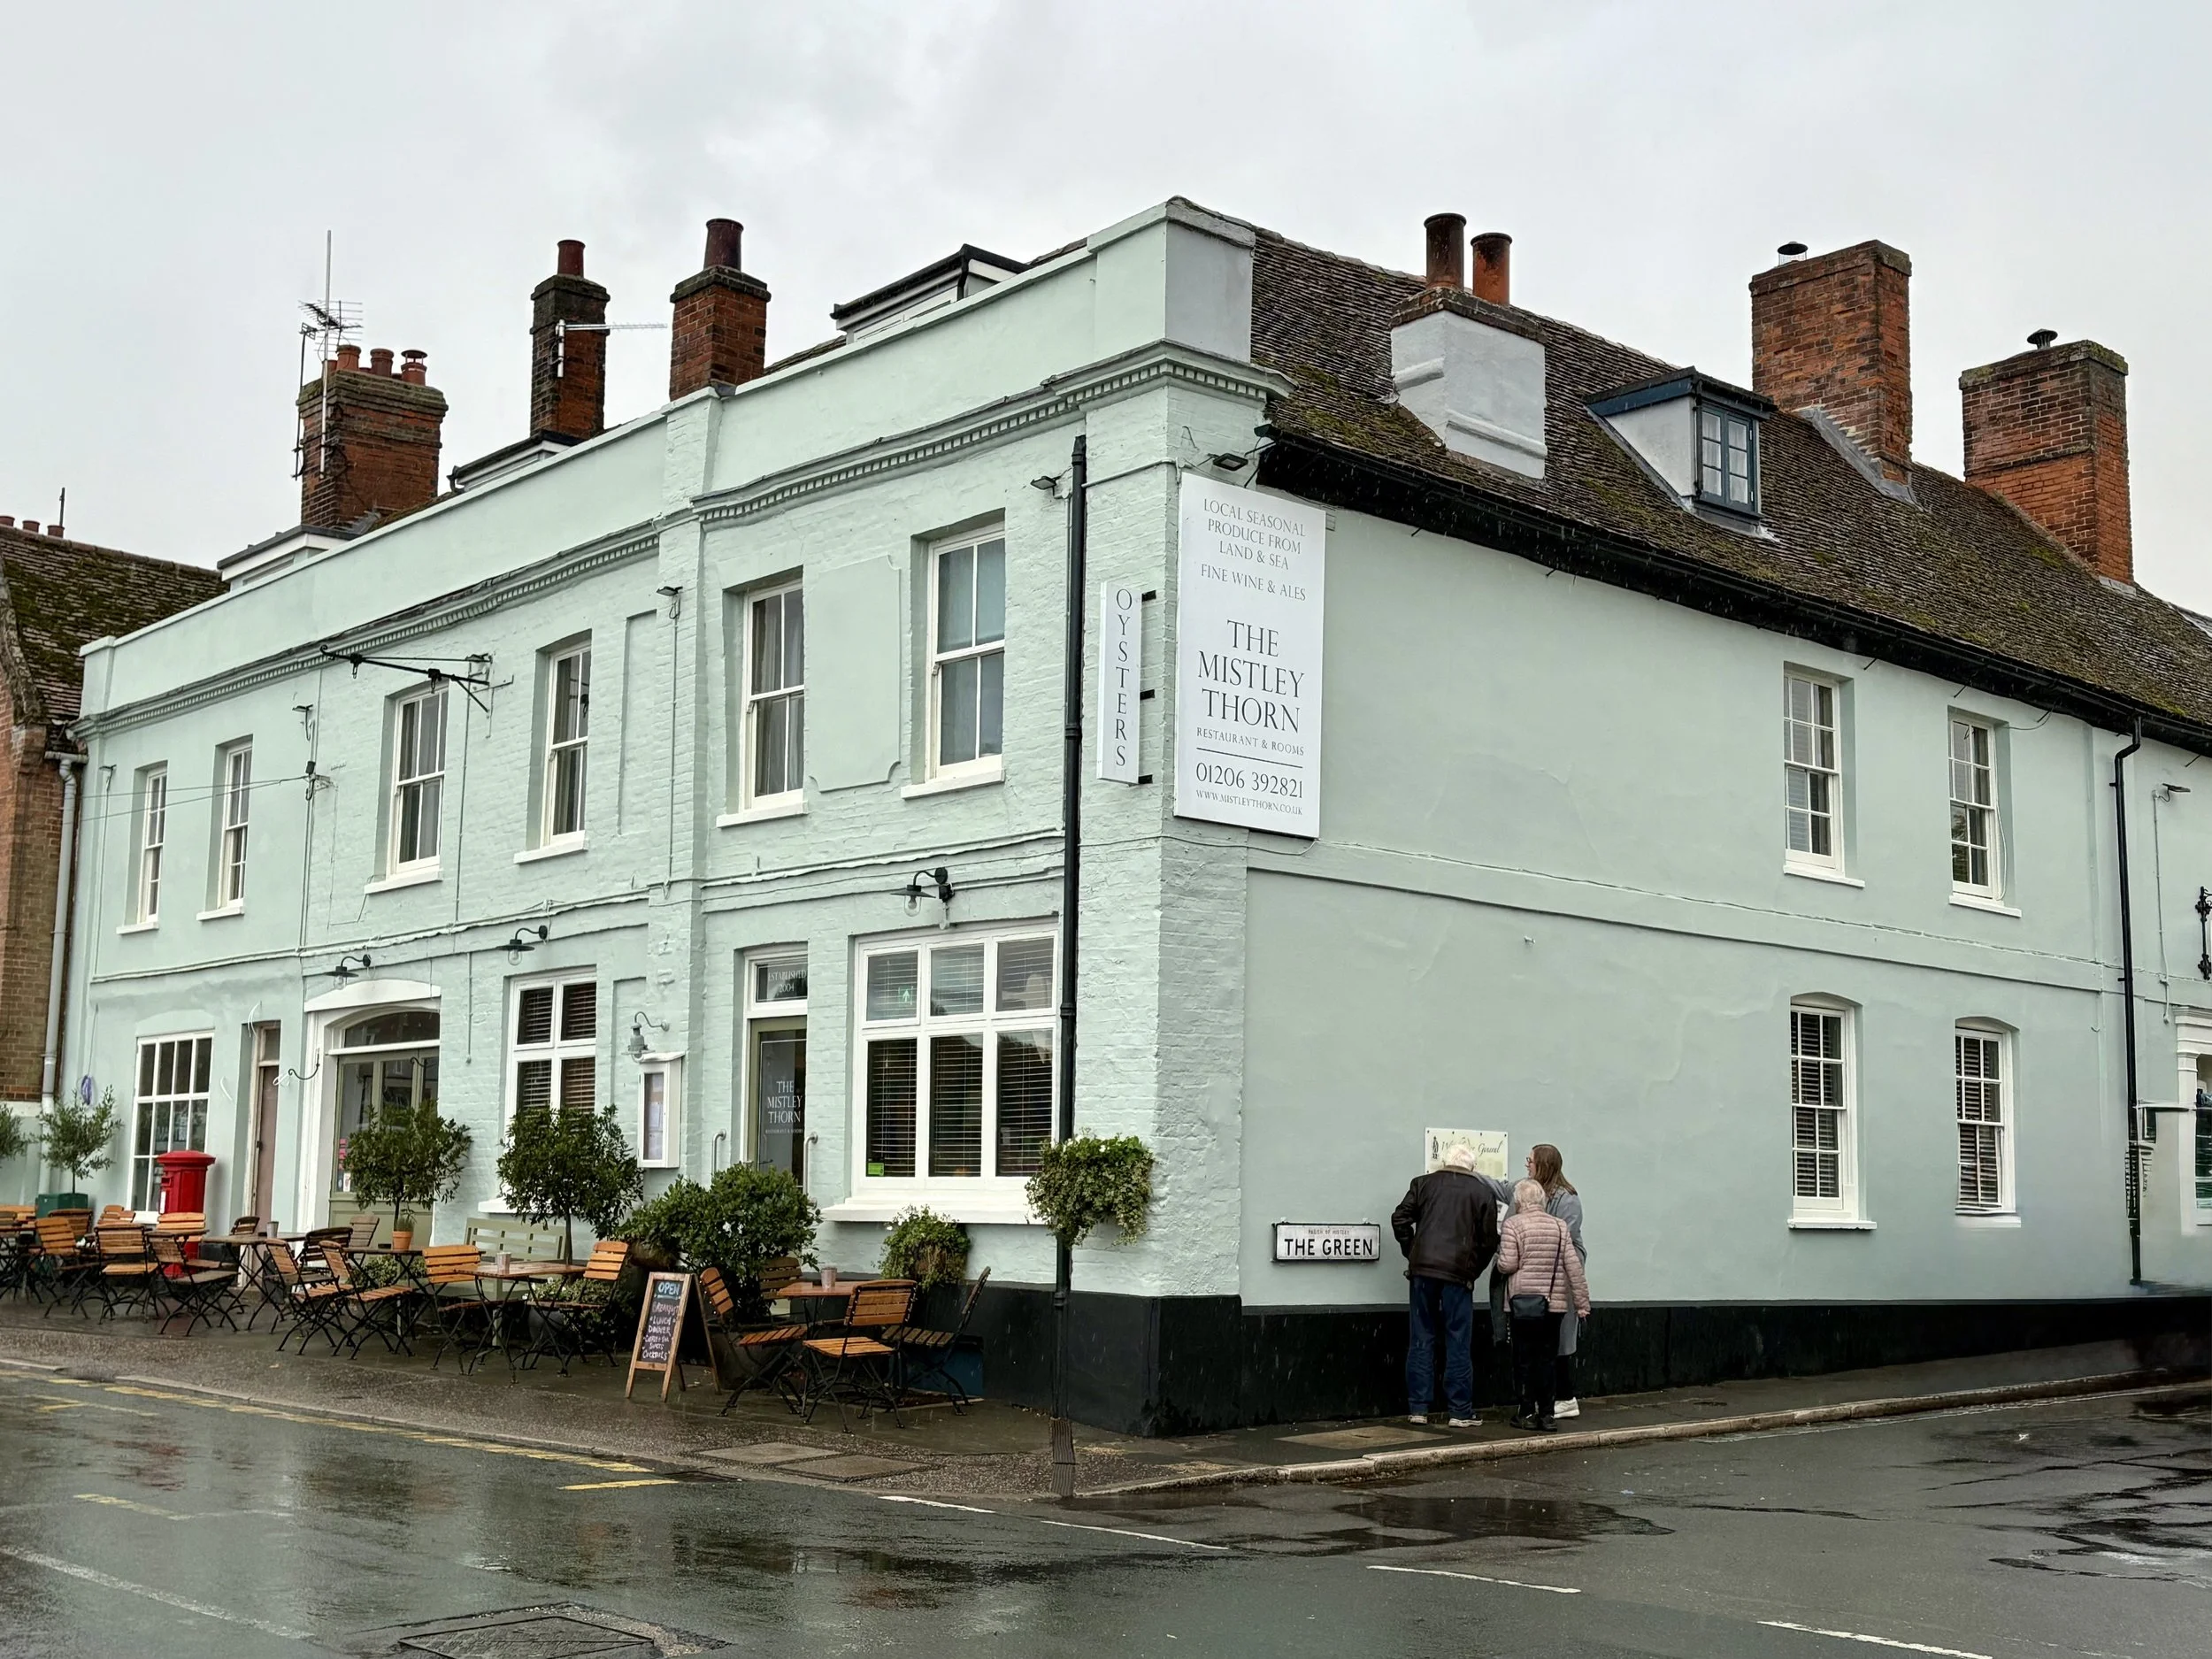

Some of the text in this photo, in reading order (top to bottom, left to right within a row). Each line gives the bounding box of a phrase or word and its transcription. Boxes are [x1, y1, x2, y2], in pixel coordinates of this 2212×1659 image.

[1203, 498, 1306, 537] LOCAL SEASONAL
[1208, 518, 1301, 555] PRODUCE FROM
[1219, 540, 1289, 570] LAND & SEA
[1201, 564, 1306, 601] FINE WINE & ALES
[1226, 619, 1279, 657] THE
[1115, 588, 1133, 766] OYSTERS
[1197, 650, 1305, 698] MISTLEY
[1202, 687, 1301, 733] THORN
[1196, 726, 1304, 756] RESTAURANT & ROOMS
[1196, 762, 1302, 798] 01206 392821
[1196, 789, 1302, 815] WWW.MISTLEYTHORN.CO.UK
[767, 1095, 803, 1109] MISTLEY
[776, 1080, 795, 1094] THE
[768, 1110, 801, 1124] THORN
[1478, 1140, 1503, 1157] General
[1285, 1239, 1372, 1256] THE GREEN
[657, 1281, 680, 1295] OPEN
